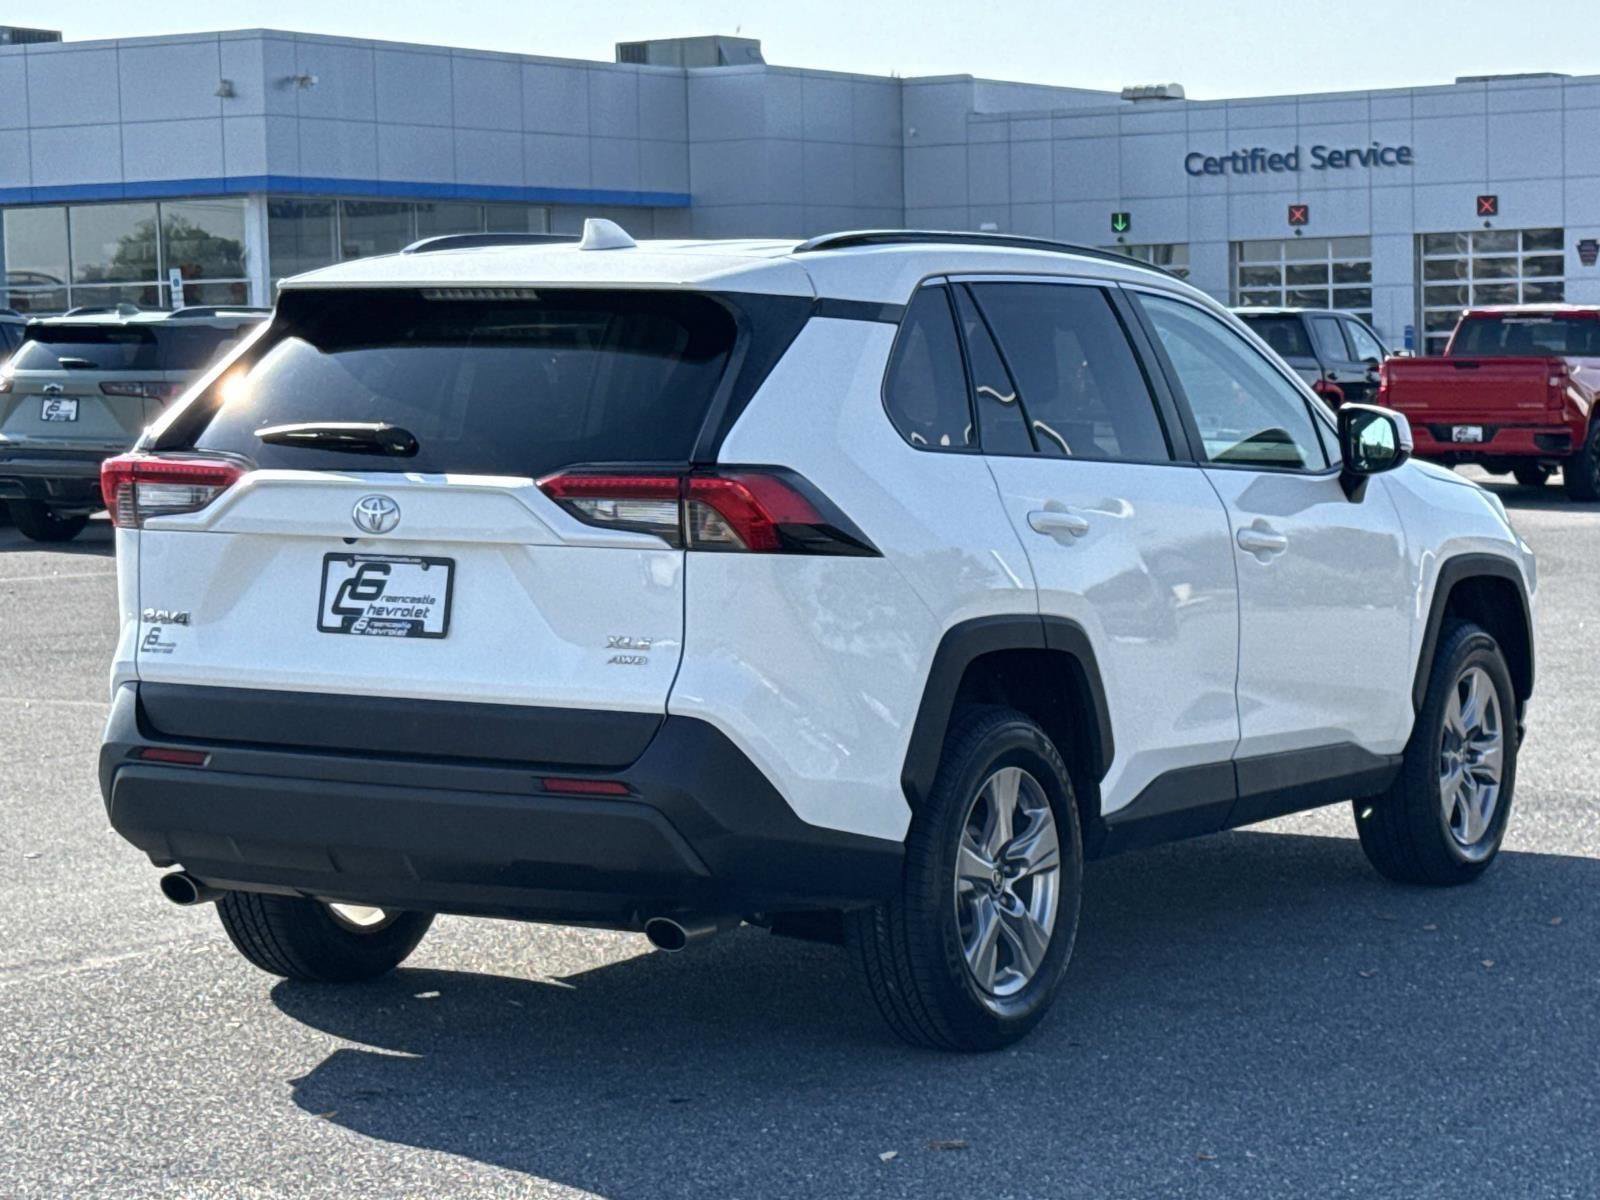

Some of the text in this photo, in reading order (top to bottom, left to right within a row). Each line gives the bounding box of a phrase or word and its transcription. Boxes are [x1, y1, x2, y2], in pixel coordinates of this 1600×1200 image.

[1184, 142, 1414, 177] Certified Service
[606, 655, 648, 666] AWD
